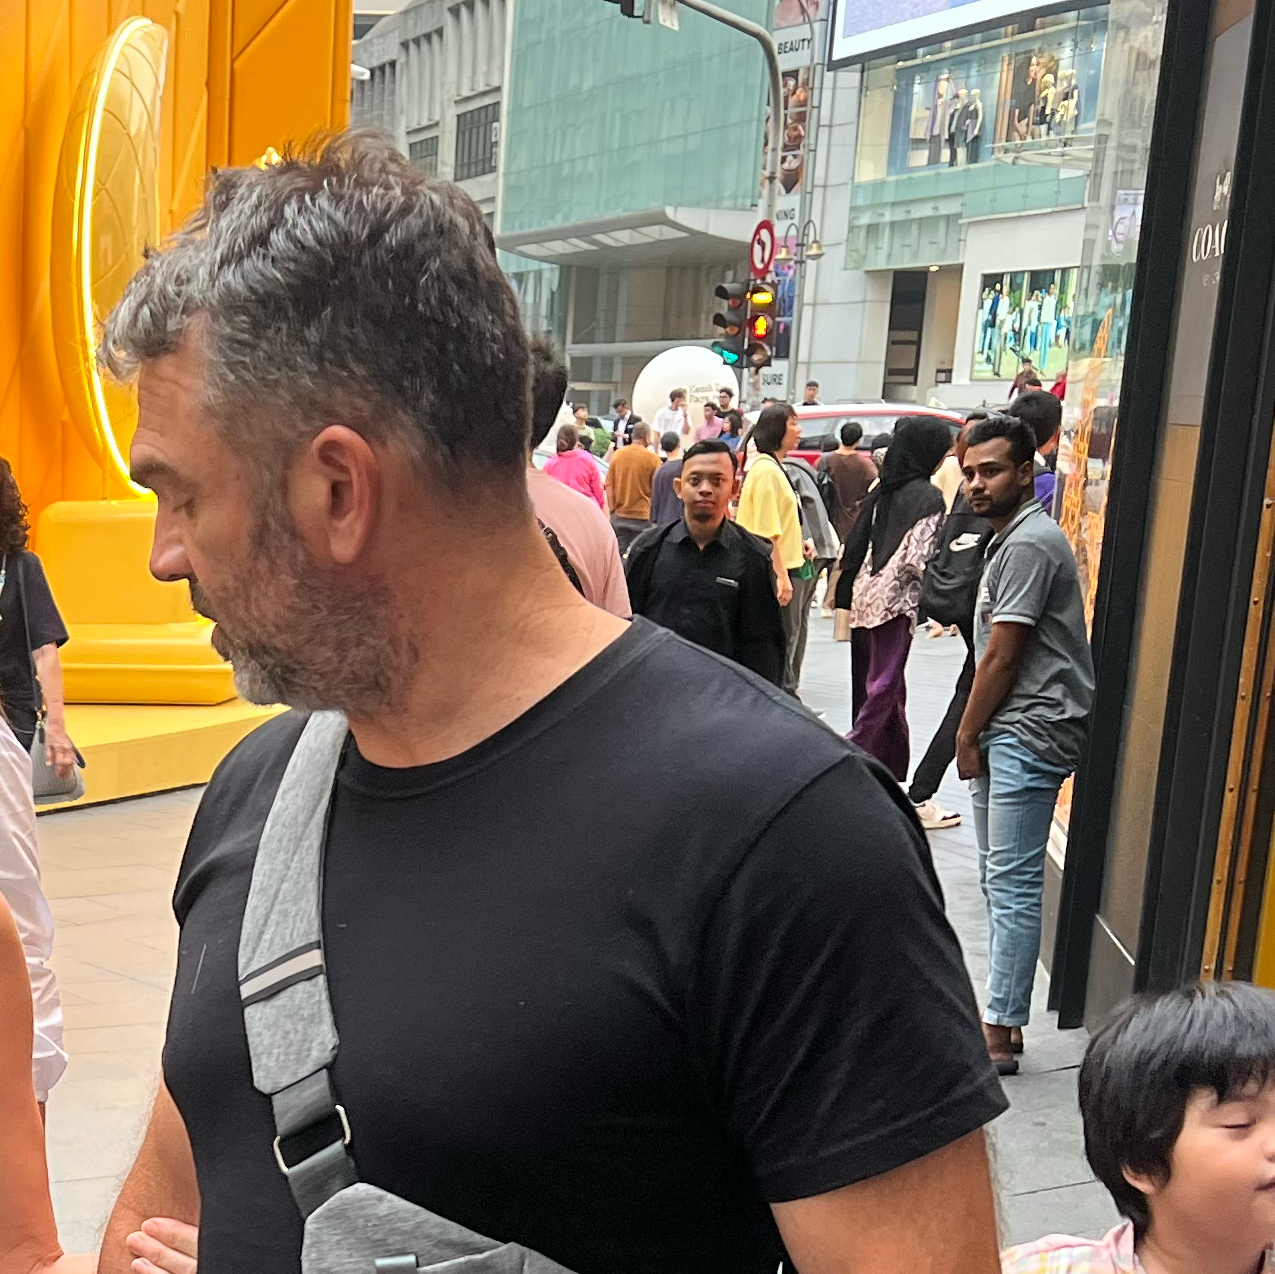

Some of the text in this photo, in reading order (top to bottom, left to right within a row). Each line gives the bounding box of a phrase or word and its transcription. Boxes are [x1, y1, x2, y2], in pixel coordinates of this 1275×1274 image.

[777, 38, 812, 55] BEAUTY
[775, 208, 796, 221] NING
[1192, 220, 1228, 263] COA
[761, 373, 784, 386] SURE
